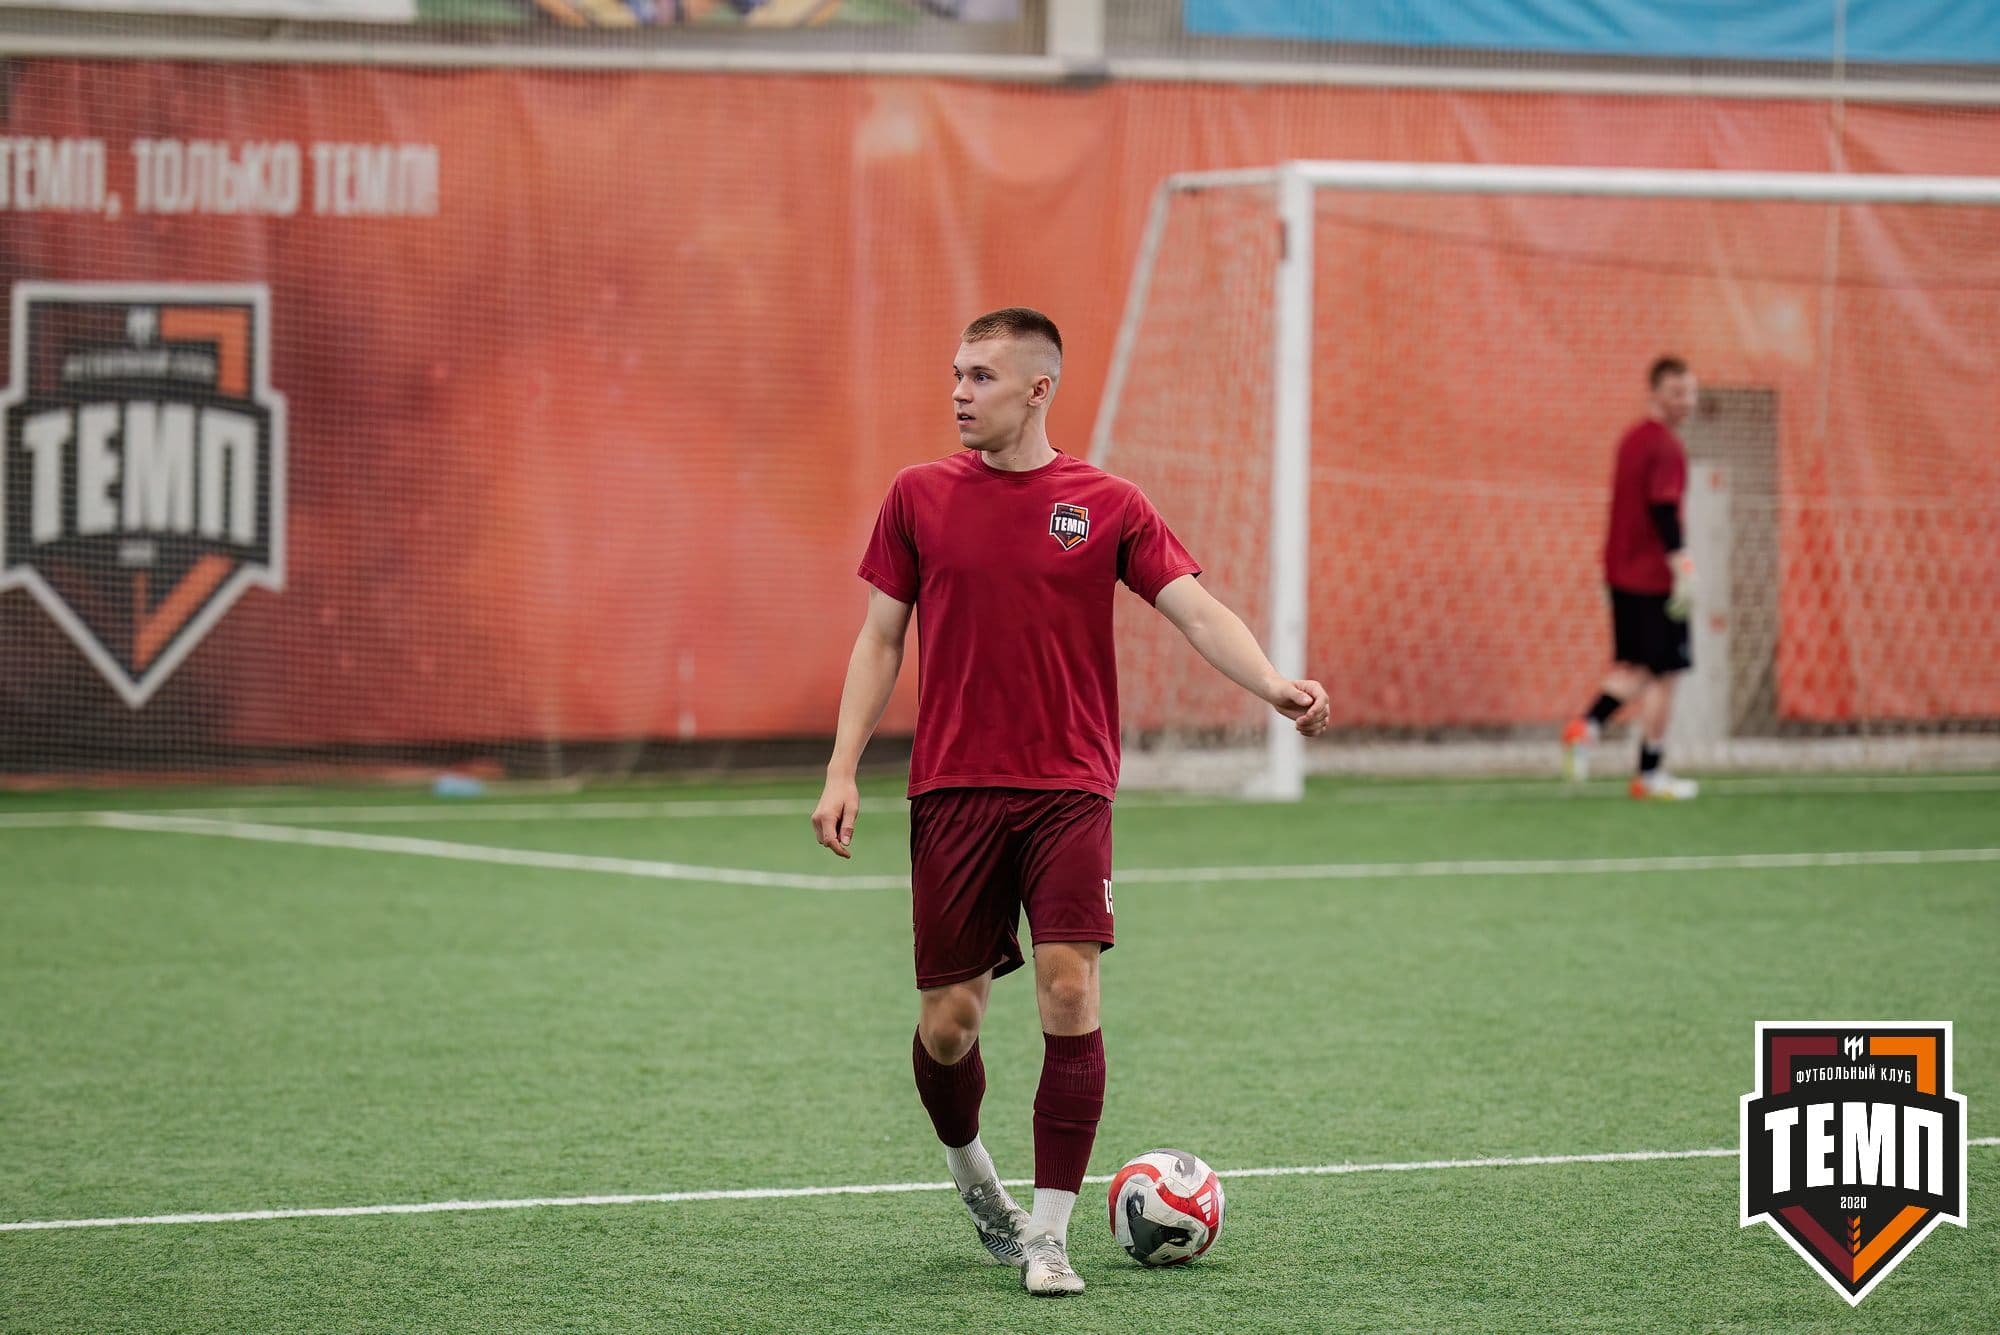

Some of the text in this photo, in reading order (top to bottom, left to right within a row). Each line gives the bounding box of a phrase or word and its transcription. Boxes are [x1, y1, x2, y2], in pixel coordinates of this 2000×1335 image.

[131, 138, 299, 215] ТОЛЬКО
[309, 142, 440, 217] ТЕМП!
[22, 400, 257, 545] ТЕМП
[1054, 516, 1086, 536] ТЕМП
